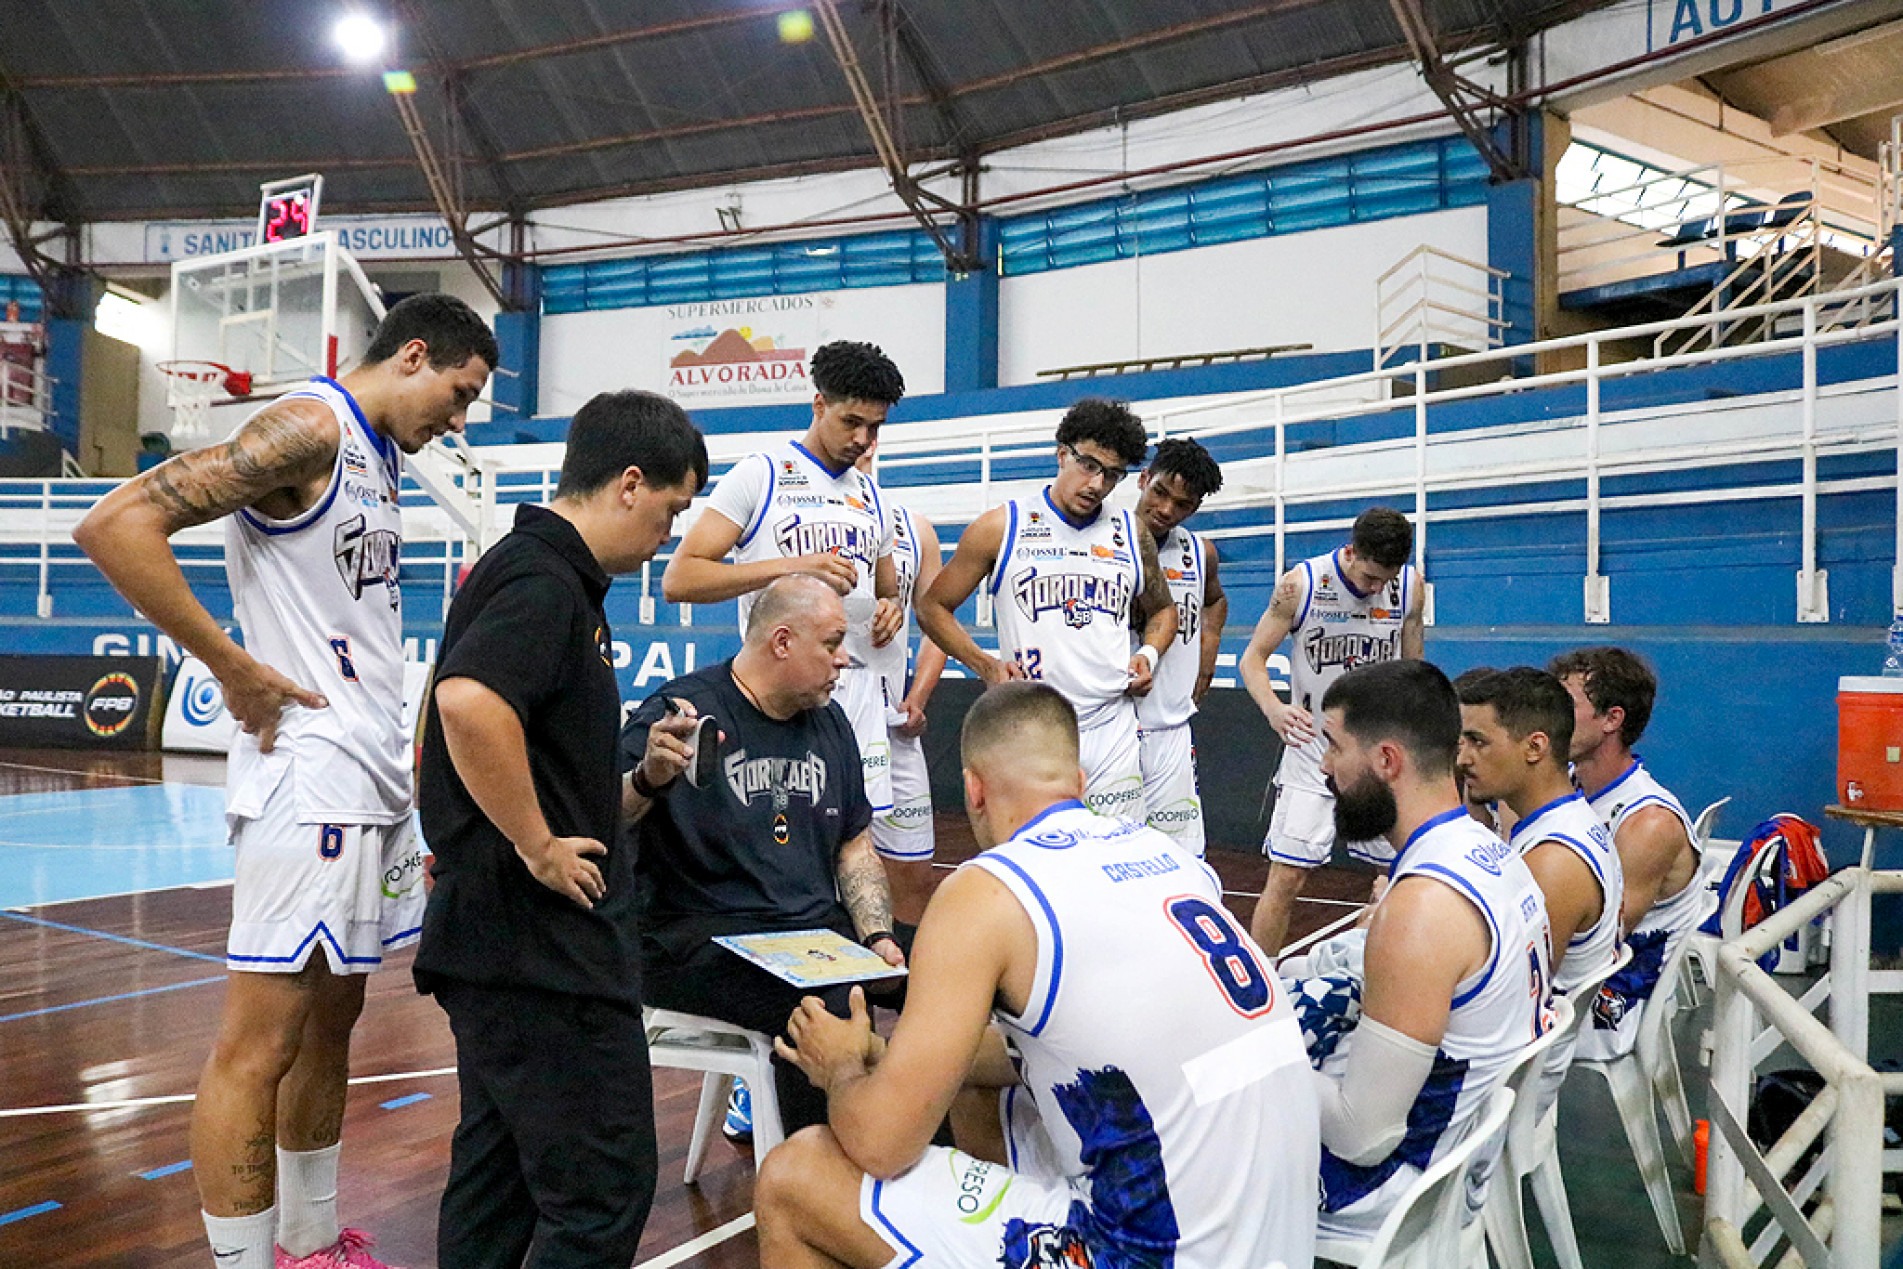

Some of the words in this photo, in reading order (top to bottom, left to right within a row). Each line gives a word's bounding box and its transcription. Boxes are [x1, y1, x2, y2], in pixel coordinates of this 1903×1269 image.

[183, 231, 256, 254] SANIT
[337, 225, 449, 250] ASCULINO
[667, 295, 813, 319] SUPERMERCADOS
[669, 361, 806, 387] ALVORADA
[1011, 566, 1133, 626] SOROCABA
[20, 690, 83, 702] PAULISTA
[89, 696, 134, 712] FPB
[1101, 852, 1181, 883] CASTELLO
[1162, 893, 1275, 1020] 8
